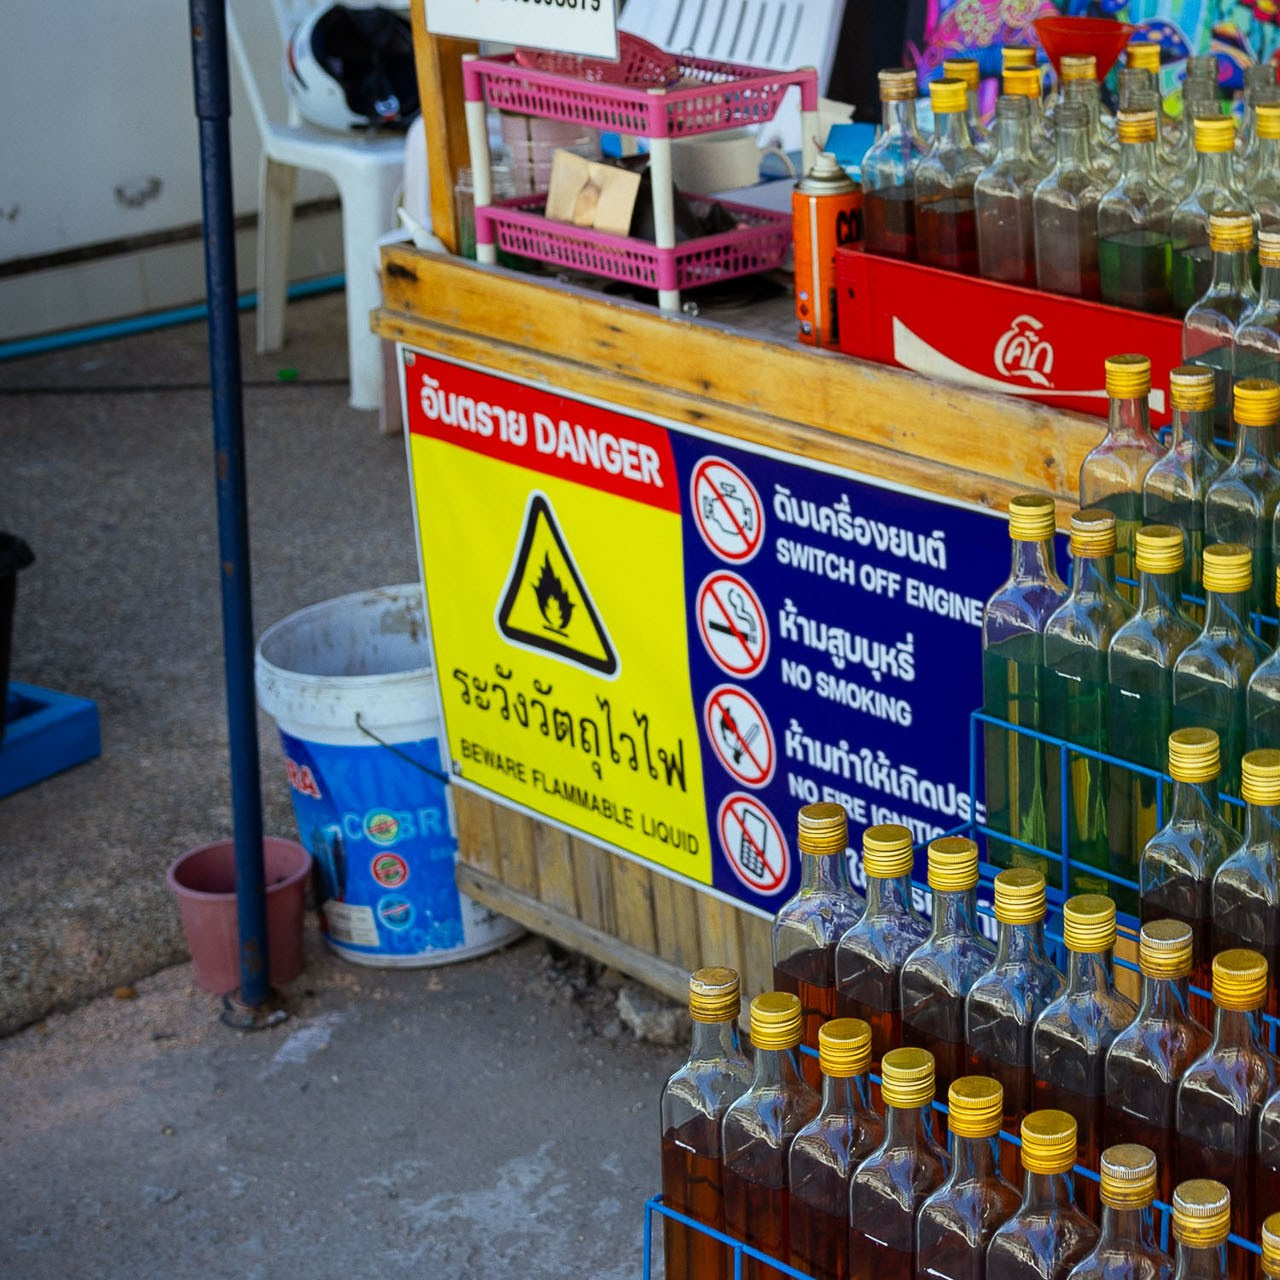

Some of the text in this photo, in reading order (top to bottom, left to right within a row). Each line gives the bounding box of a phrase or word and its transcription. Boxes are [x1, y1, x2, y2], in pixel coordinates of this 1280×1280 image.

[420, 373, 664, 489] อันตราย DANGER
[773, 483, 947, 570] ดับเครื่องยนต์
[775, 537, 984, 628] SWITCH OFF ENGINE
[779, 598, 916, 682] ห้ามสูบบุหรี่
[453, 663, 688, 794] ระวังวัตถุไวไฟ
[781, 658, 913, 727] NO SMOKING
[460, 738, 700, 857] BEWARE FLAMMABLE LIQUID
[787, 772, 820, 805] NO
[822, 786, 868, 826] FIRE
